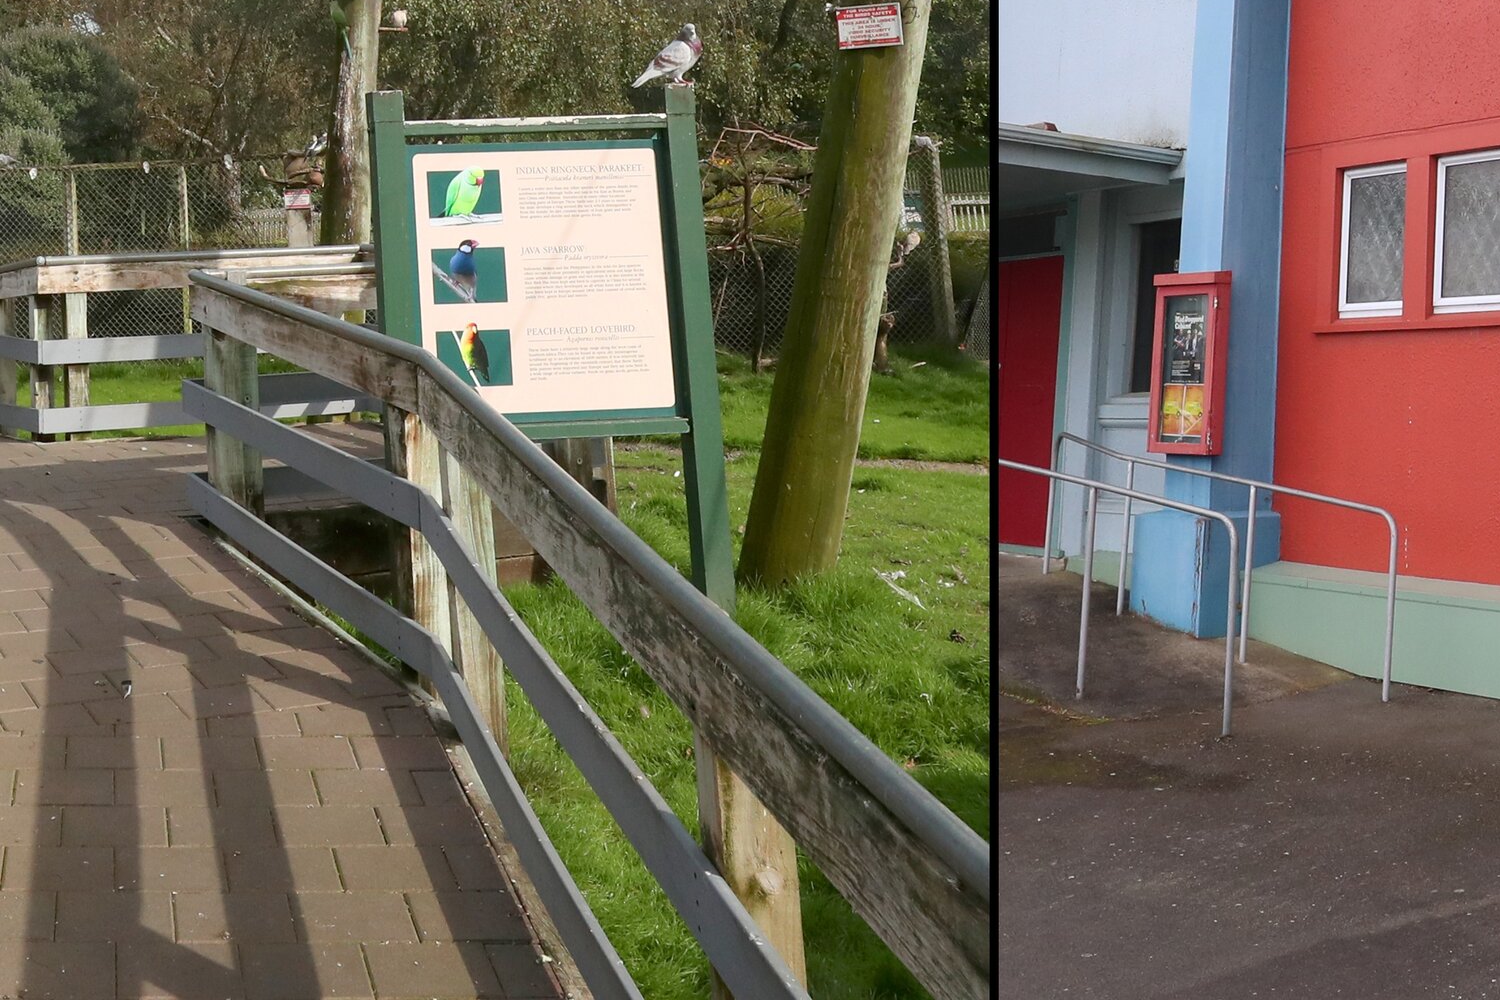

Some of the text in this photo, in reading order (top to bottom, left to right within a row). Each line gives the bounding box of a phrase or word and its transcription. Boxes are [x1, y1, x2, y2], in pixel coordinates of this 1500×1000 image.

[515, 163, 642, 175] INDIAN RINGNECK PARAKEET
[520, 245, 585, 257] JAVA SPARROW
[526, 324, 636, 336] PEACH-FACED LOVEBIRD
